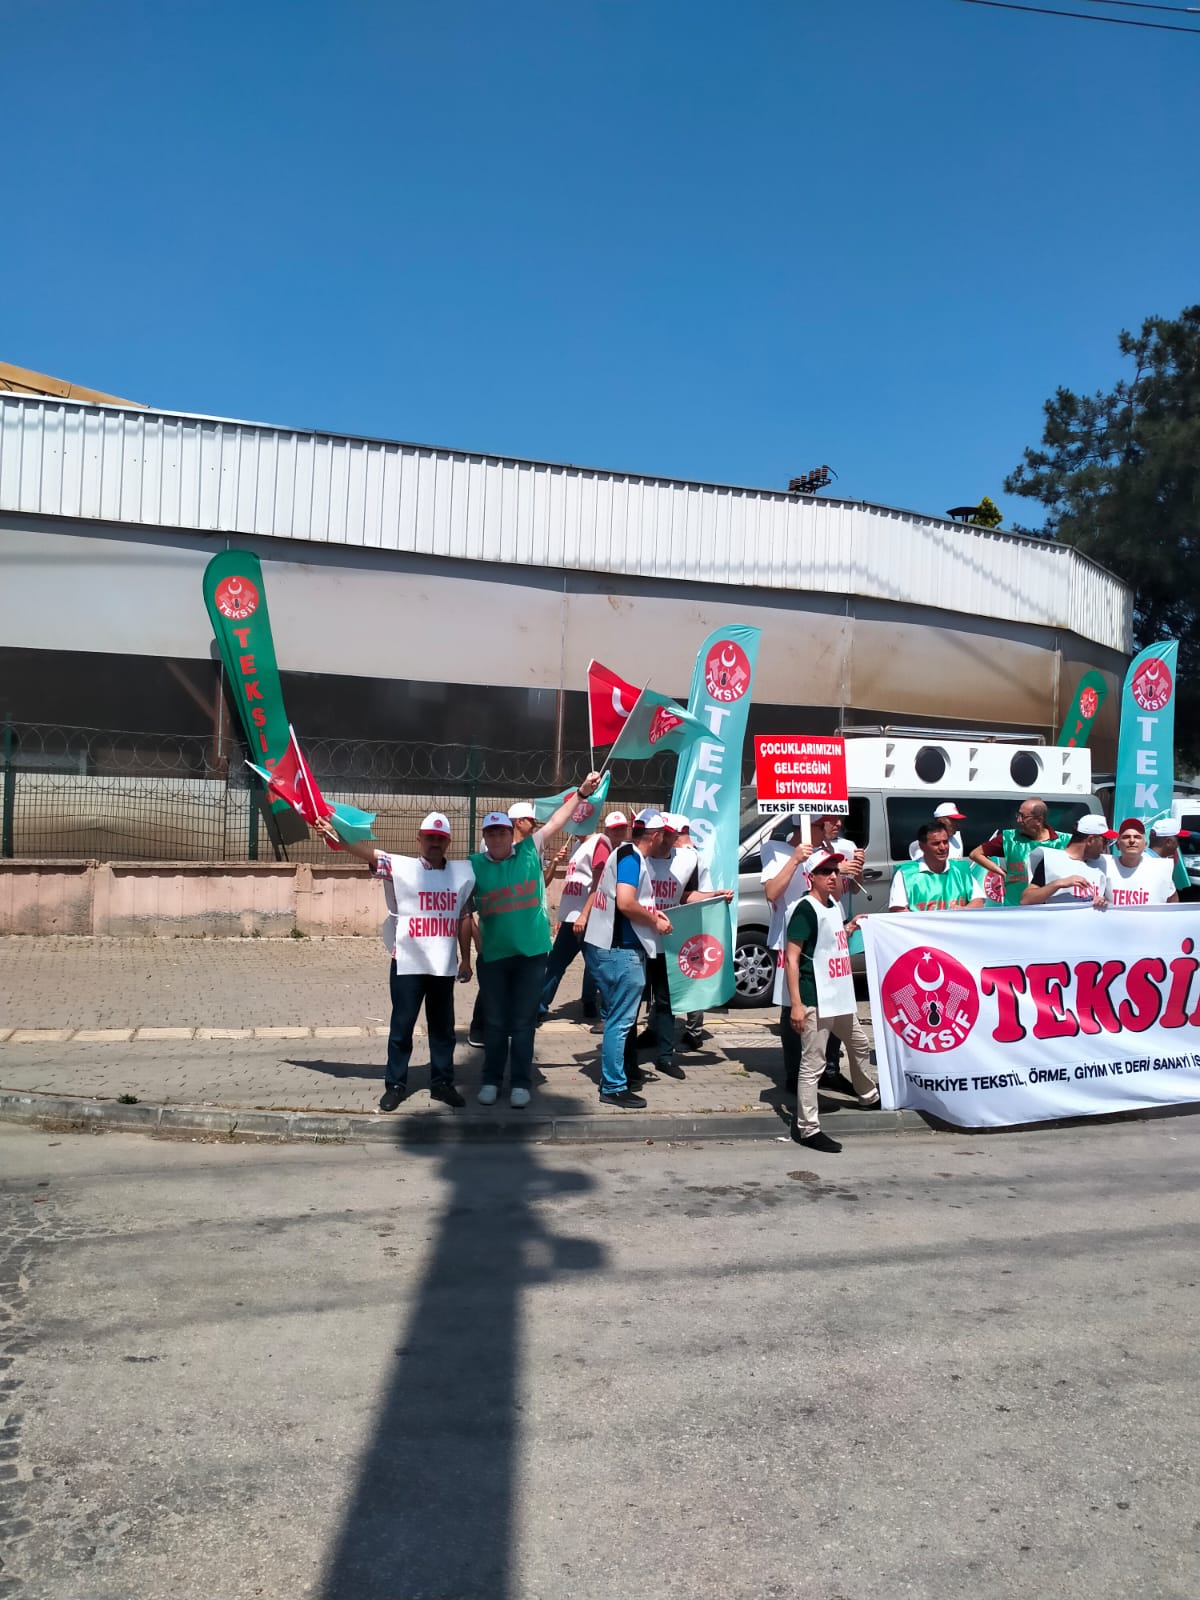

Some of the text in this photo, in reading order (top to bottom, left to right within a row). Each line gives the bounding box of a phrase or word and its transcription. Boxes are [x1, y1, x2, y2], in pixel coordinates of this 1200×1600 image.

[760, 743, 842, 758] ÇOCUKLARIMIZIN
[774, 760, 832, 775] GELECEĞİNİ
[1134, 716, 1159, 821] TEK
[775, 779, 827, 794] İSTİYORUZ
[760, 801, 848, 813] TEKSİF SENDİKASI
[418, 887, 458, 912] TEKSİF
[1112, 887, 1150, 906] TEKSİF
[980, 937, 1200, 1043] TEKSİ
[890, 1007, 972, 1051] TEKSİF
[971, 1070, 1027, 1091] TEKSTİL,
[1028, 1067, 1070, 1083] ÖRME,
[1074, 1061, 1108, 1080] GİYİM
[1108, 1062, 1123, 1076] VE
[1125, 1056, 1150, 1074] DERİ
[1153, 1052, 1191, 1071] SANAYİ
